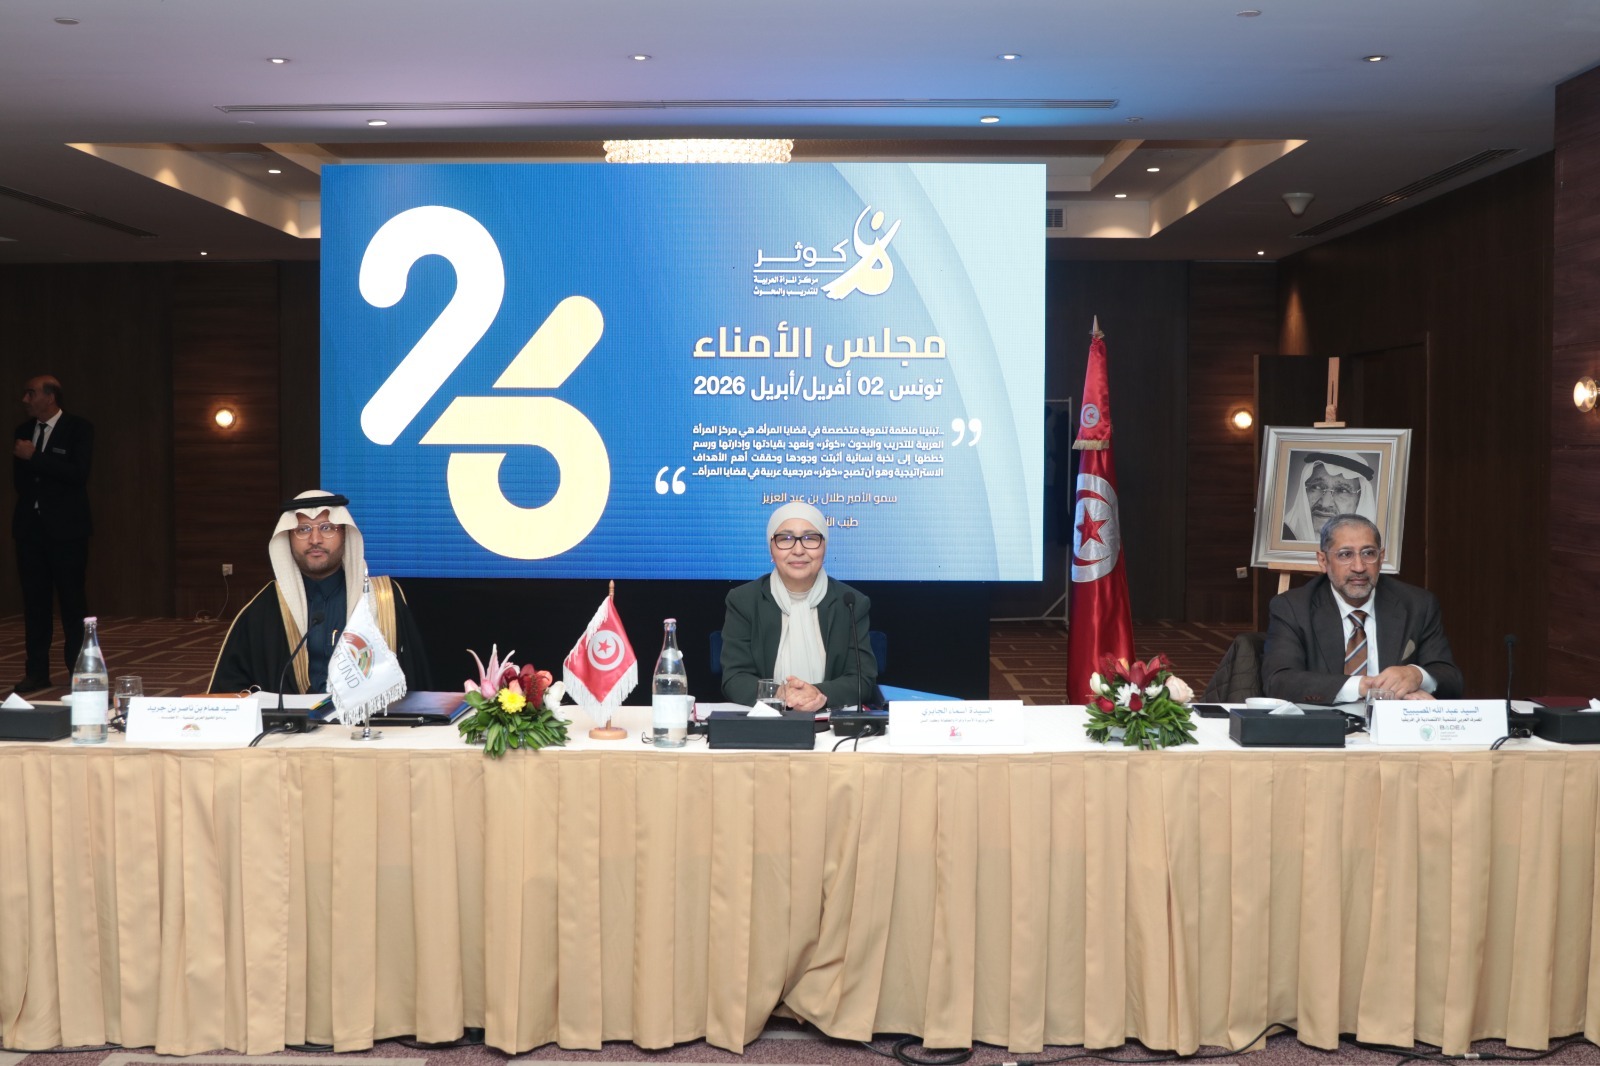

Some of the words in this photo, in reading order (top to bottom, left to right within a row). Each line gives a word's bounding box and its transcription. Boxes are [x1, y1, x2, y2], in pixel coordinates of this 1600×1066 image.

[753, 238, 849, 267] كوثر
[693, 320, 812, 358] الأمناء
[825, 327, 946, 368] مجلس
[693, 375, 746, 395] 2026
[750, 369, 852, 401] أفريل/أبريل
[857, 376, 884, 395] 02
[889, 378, 944, 401] تونس
[692, 423, 717, 436] المرأة
[718, 426, 738, 436] مركز
[738, 427, 755, 438] هي
[783, 426, 807, 437] قضايا
[808, 426, 821, 438] في
[821, 426, 859, 435] متخصصة
[860, 426, 888, 437] تنموية
[888, 426, 917, 435] منظمة
[692, 440, 717, 451] ورسم
[718, 440, 750, 450] وإدارتها
[752, 440, 786, 450] بقيادتها
[847, 439, 881, 450] والبحوث
[883, 440, 914, 450] للتدريب
[915, 440, 944, 450] العربية
[692, 452, 727, 462] الأهداف
[730, 451, 748, 464] أهم
[750, 453, 783, 464] وحققت
[785, 453, 817, 464] وجودها
[820, 451, 842, 464] أثبتت
[845, 453, 873, 464] نسائية
[876, 453, 894, 464] نخبة
[897, 453, 911, 465] إلى
[914, 453, 944, 464] خططها
[723, 467, 747, 478] قضايا
[747, 467, 760, 480] في
[760, 467, 782, 478] عربية
[782, 467, 813, 478] مرجعية
[843, 467, 864, 478] تصبح
[864, 465, 874, 478] أن
[875, 468, 893, 478] وهو
[894, 467, 944, 478] الاستراتيجية
[762, 492, 787, 504] العزيز
[807, 494, 819, 505] بن
[821, 493, 845, 504] طلال
[846, 492, 871, 504] الأمير
[873, 494, 897, 504] سمو
[220, 704, 240, 713] السيد
[1460, 706, 1480, 715] السيد
